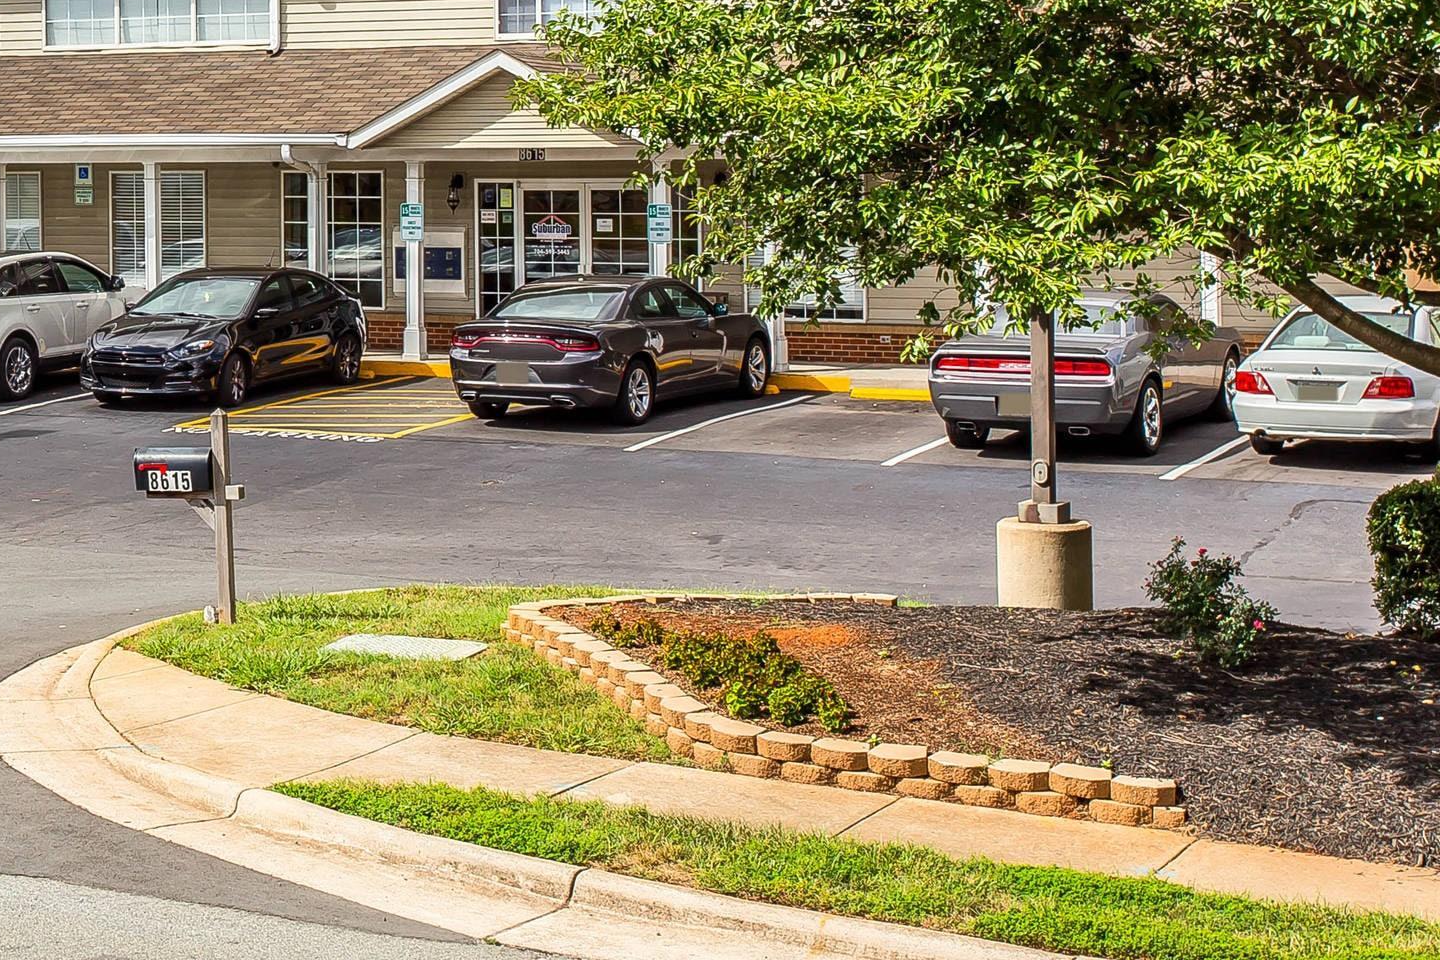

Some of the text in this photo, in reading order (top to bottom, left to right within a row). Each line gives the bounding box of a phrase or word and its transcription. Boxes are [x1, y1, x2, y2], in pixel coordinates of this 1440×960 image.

[520, 148, 545, 160] 8615
[532, 223, 572, 234] Suburban
[150, 471, 190, 490] 8615
